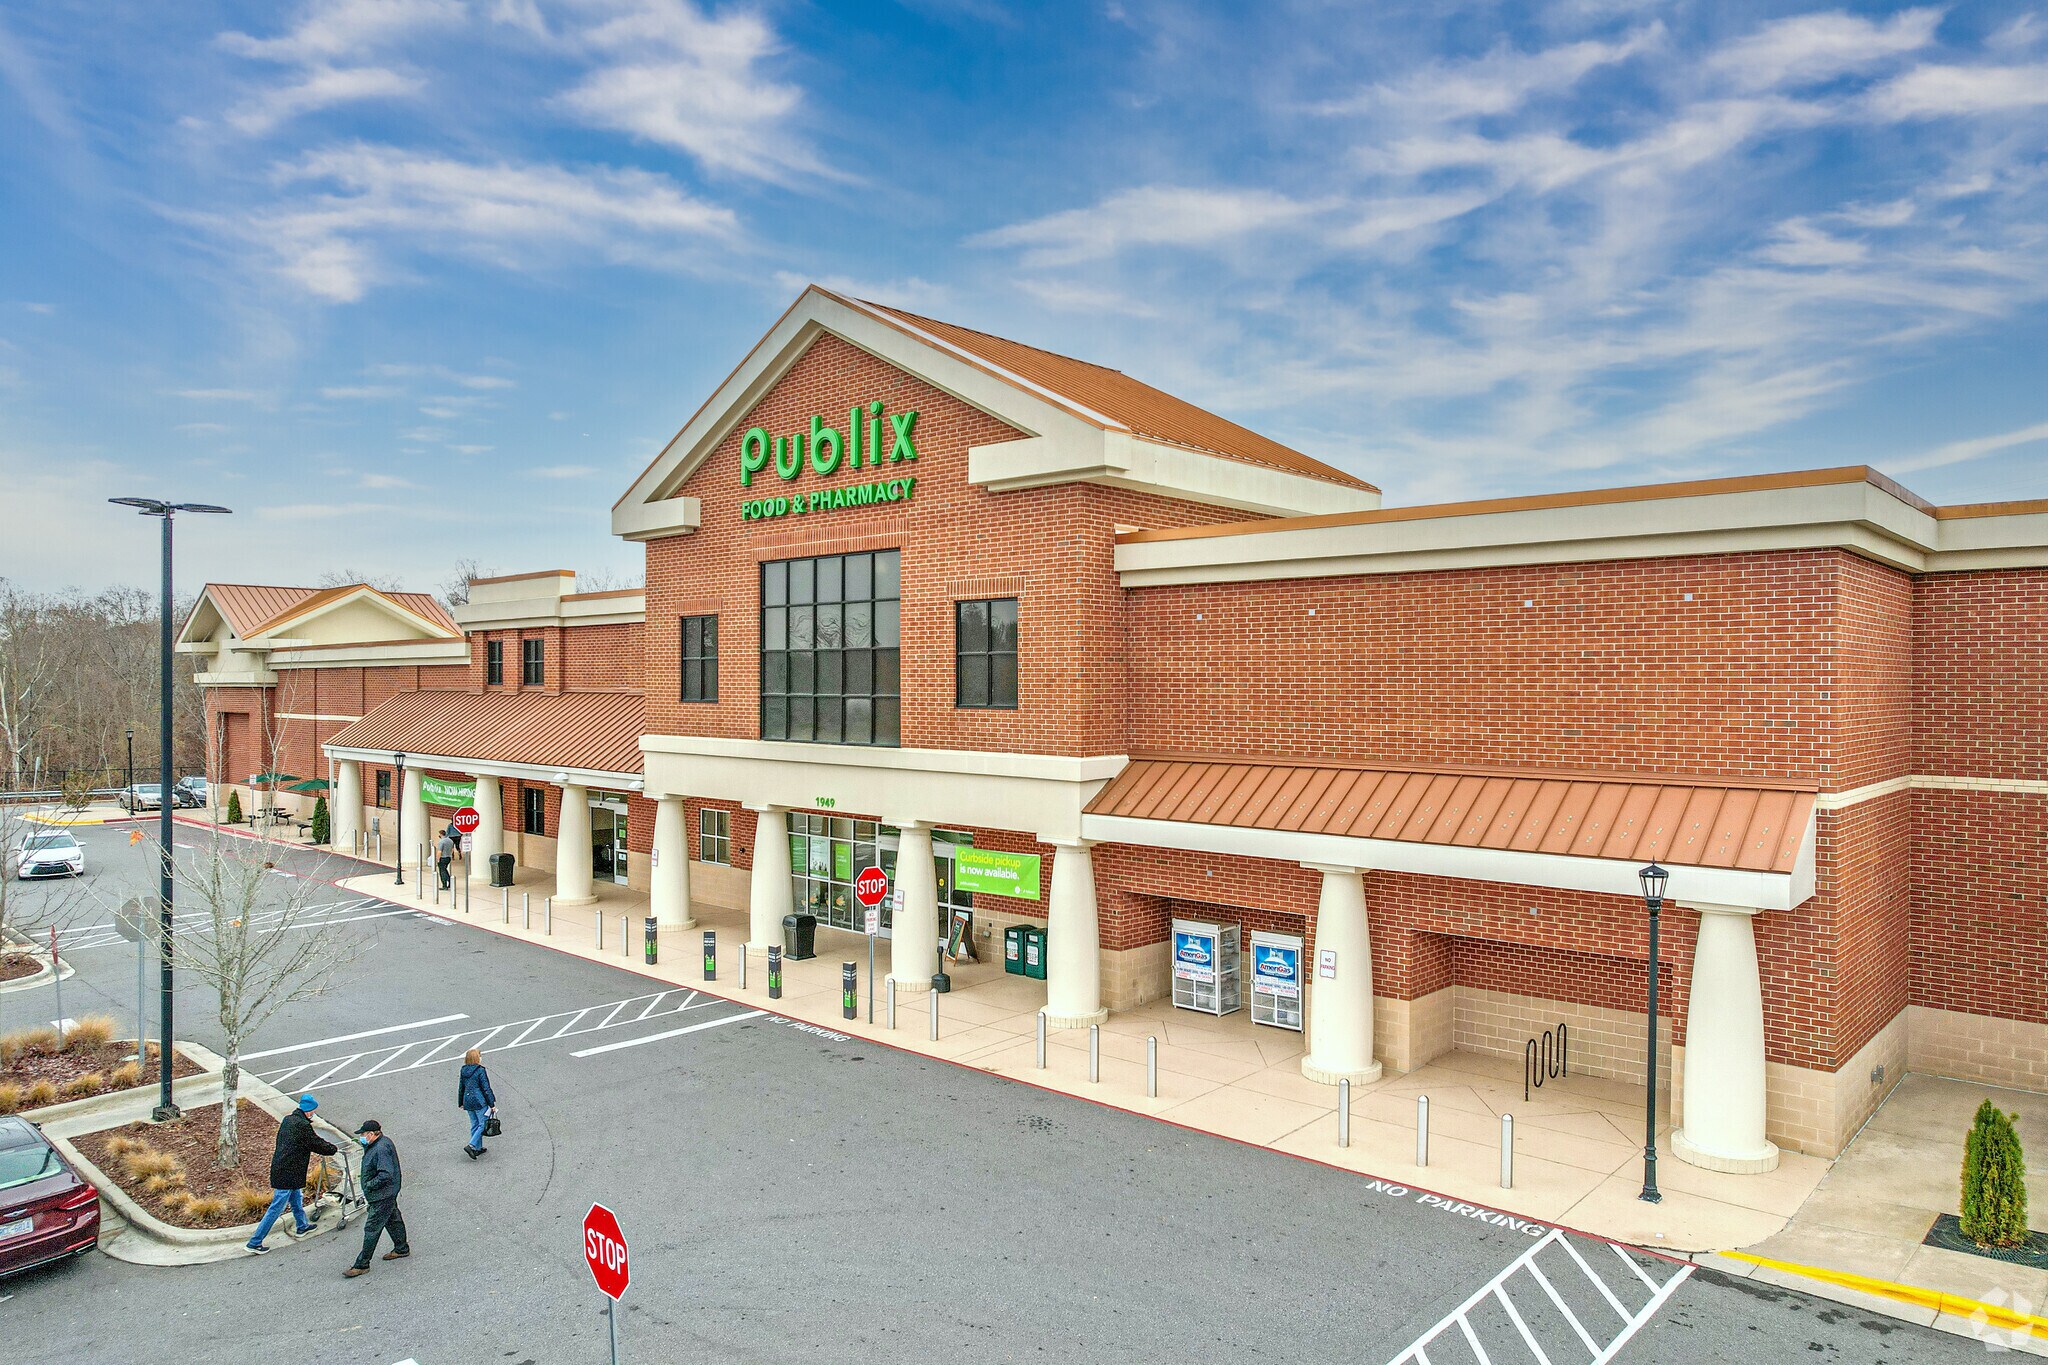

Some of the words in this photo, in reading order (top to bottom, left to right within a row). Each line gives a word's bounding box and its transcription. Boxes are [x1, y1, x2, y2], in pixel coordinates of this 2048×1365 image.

[742, 497, 790, 521] FOOD
[792, 494, 807, 514] &
[810, 478, 916, 511] PHARMACY
[815, 796, 835, 808] 1949
[455, 815, 478, 826] STOP
[960, 851, 993, 864] Curbside
[994, 855, 1020, 869] pickup
[960, 864, 966, 873] is
[967, 866, 983, 876] now
[984, 867, 1019, 880] available.
[858, 878, 885, 895] STOP
[1180, 950, 1207, 959] AmeriGas
[1260, 963, 1291, 973] AmeriGas
[764, 1016, 790, 1024] NO
[787, 1022, 851, 1042] PARKING
[1365, 1180, 1408, 1197] NO
[1415, 1194, 1546, 1237] PARKING
[587, 1228, 626, 1275] STOP
